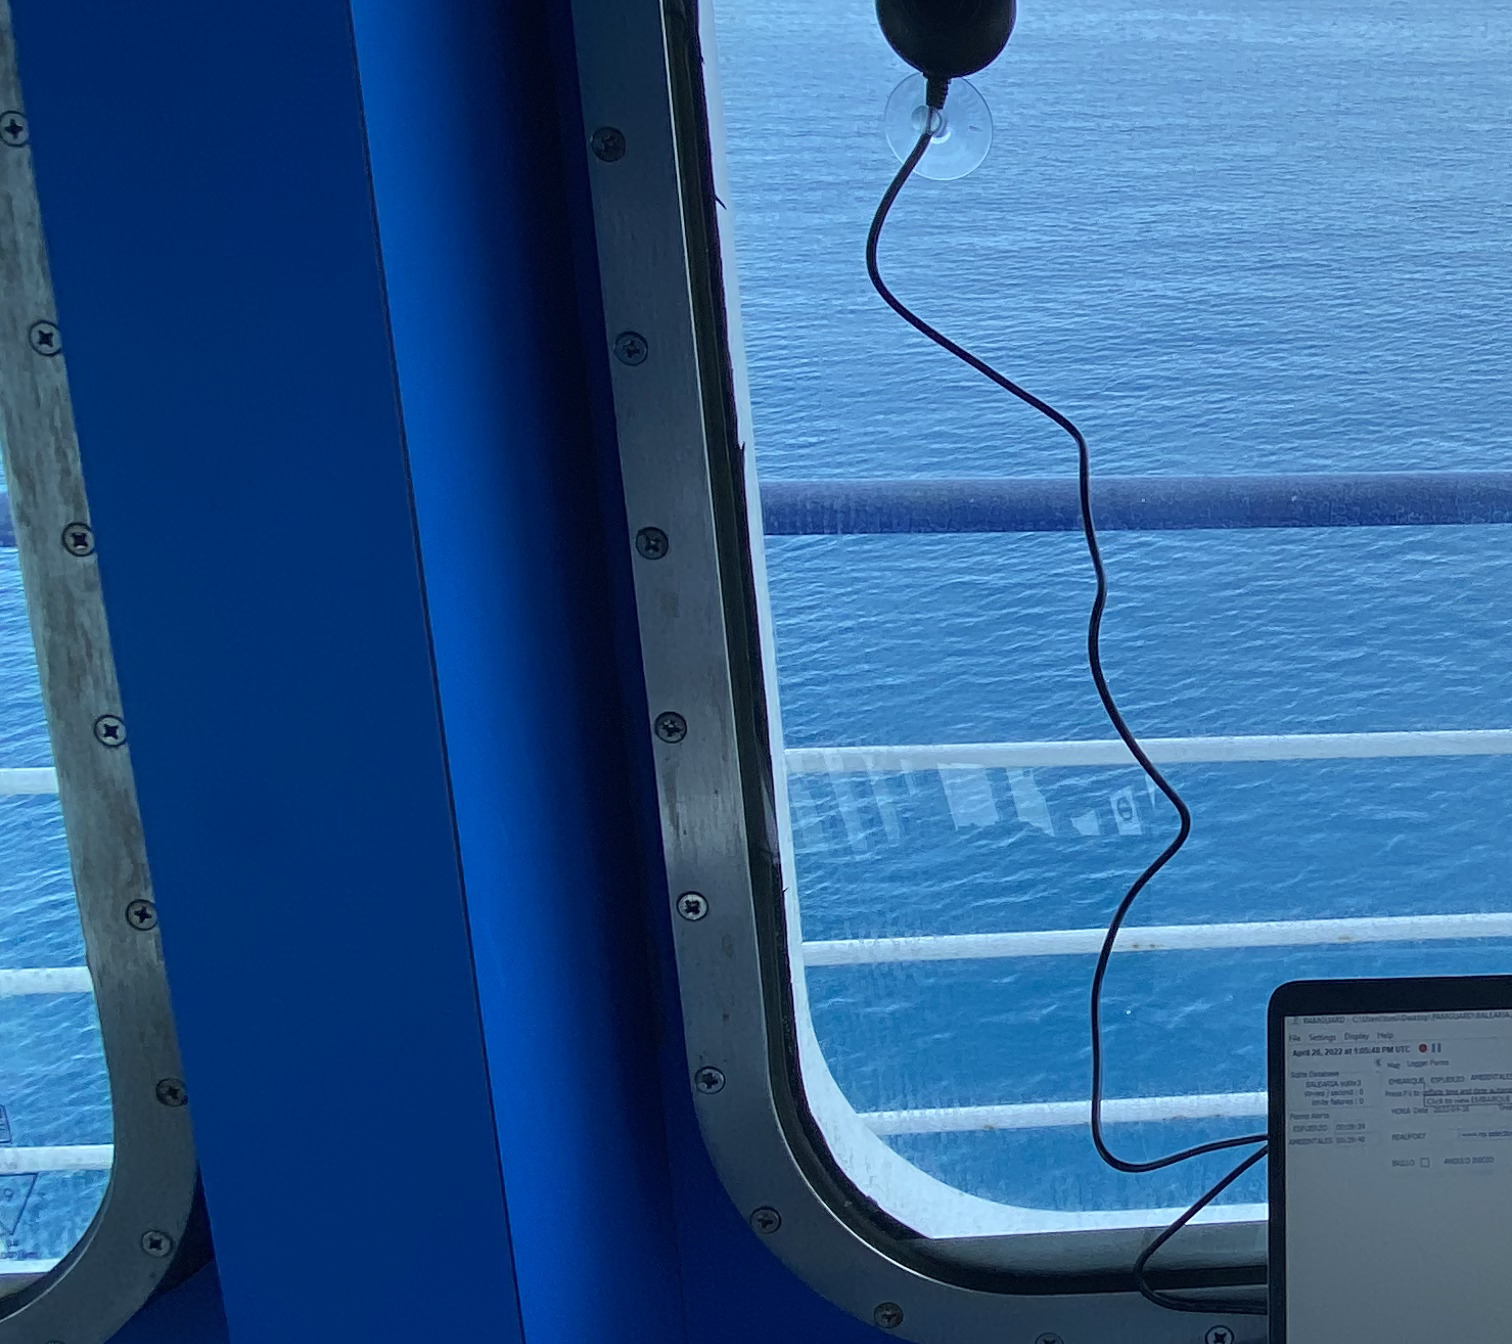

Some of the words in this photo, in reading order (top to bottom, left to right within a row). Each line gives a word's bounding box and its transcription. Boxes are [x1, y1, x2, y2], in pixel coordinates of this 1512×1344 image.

[1309, 1033, 1336, 1042] Settings
[1344, 1032, 1369, 1041] Display
[1377, 1031, 1393, 1040] Help
[1382, 1045, 1394, 1053] PM
[1395, 1045, 1410, 1053] UTC
